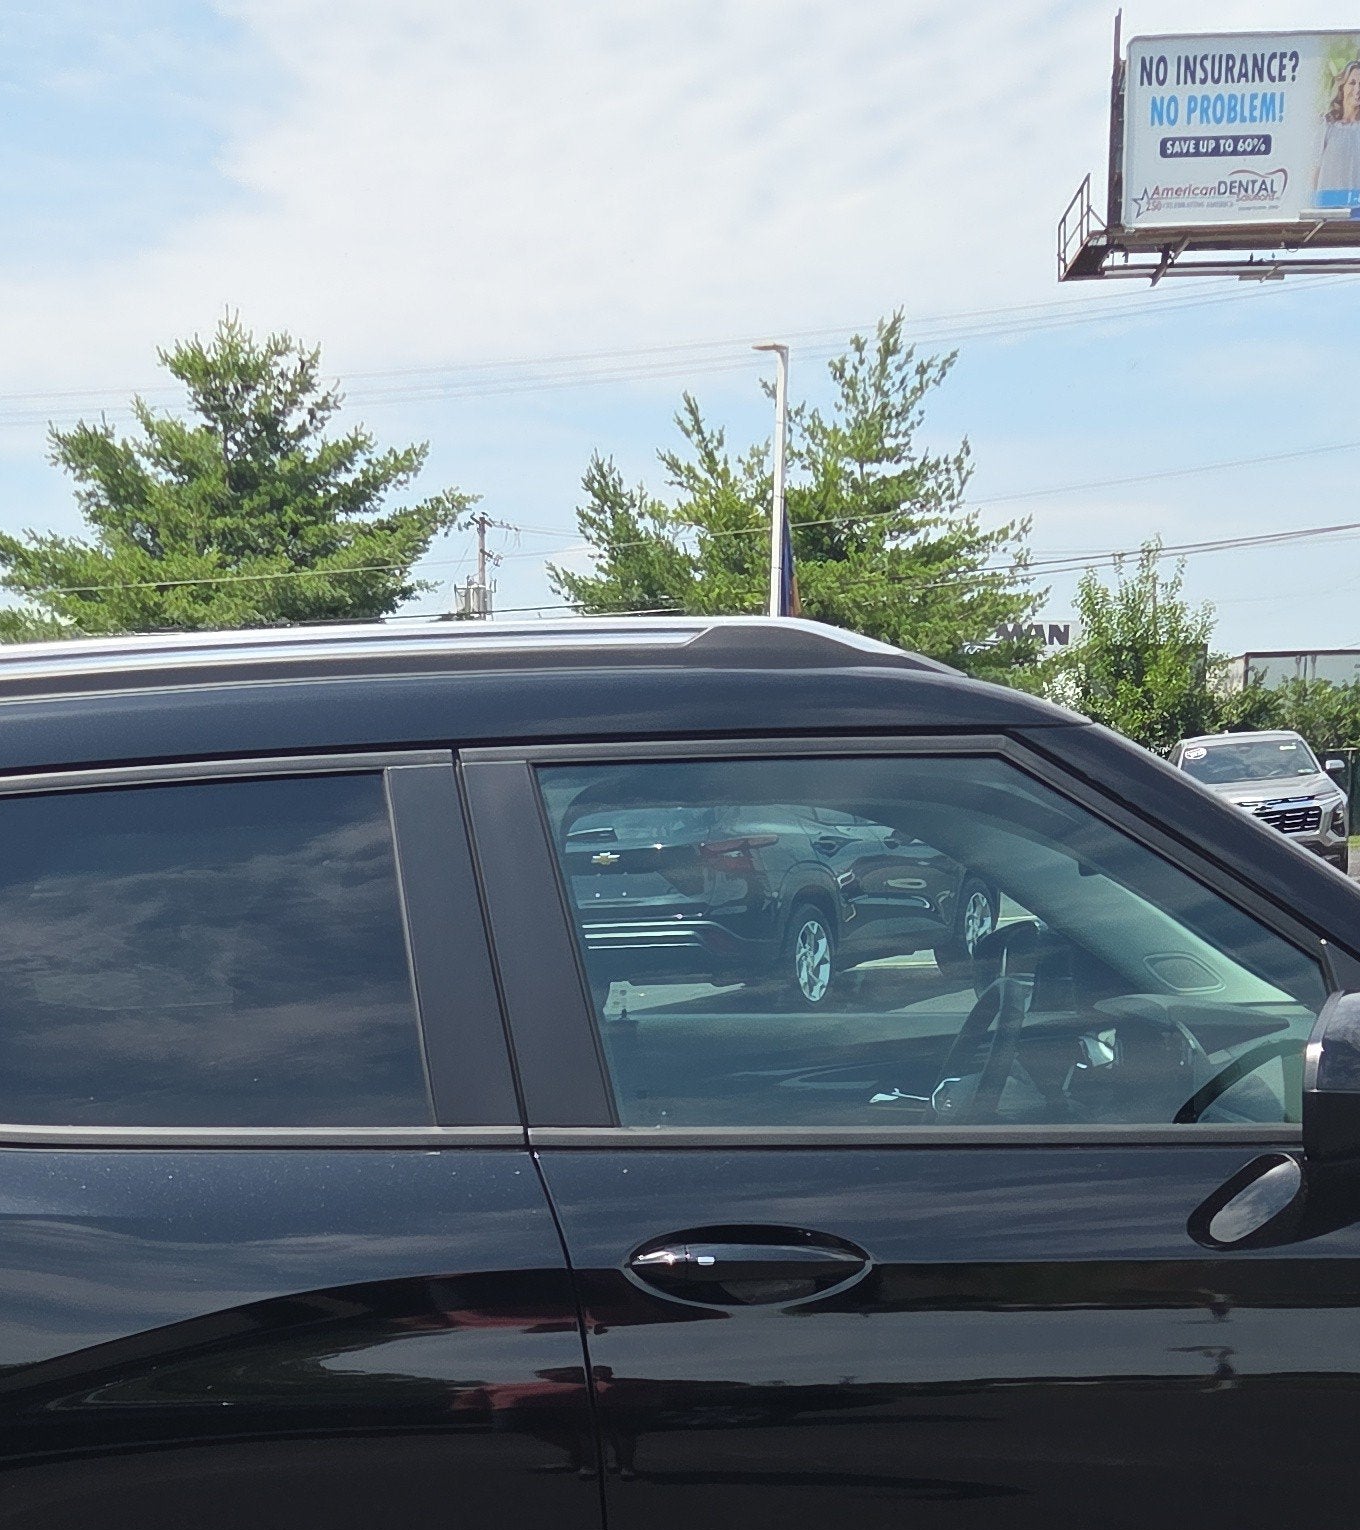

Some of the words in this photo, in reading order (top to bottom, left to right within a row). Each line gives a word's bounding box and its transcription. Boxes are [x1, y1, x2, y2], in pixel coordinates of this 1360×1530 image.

[1140, 55, 1168, 86] NO
[1176, 51, 1299, 86] INSURANCE?
[1150, 94, 1179, 126] NO
[1186, 91, 1285, 125] PROBLEM!
[1166, 139, 1196, 154] SAVE
[1199, 139, 1216, 153] UP
[1219, 138, 1233, 153] TO
[1238, 137, 1266, 153] 60%
